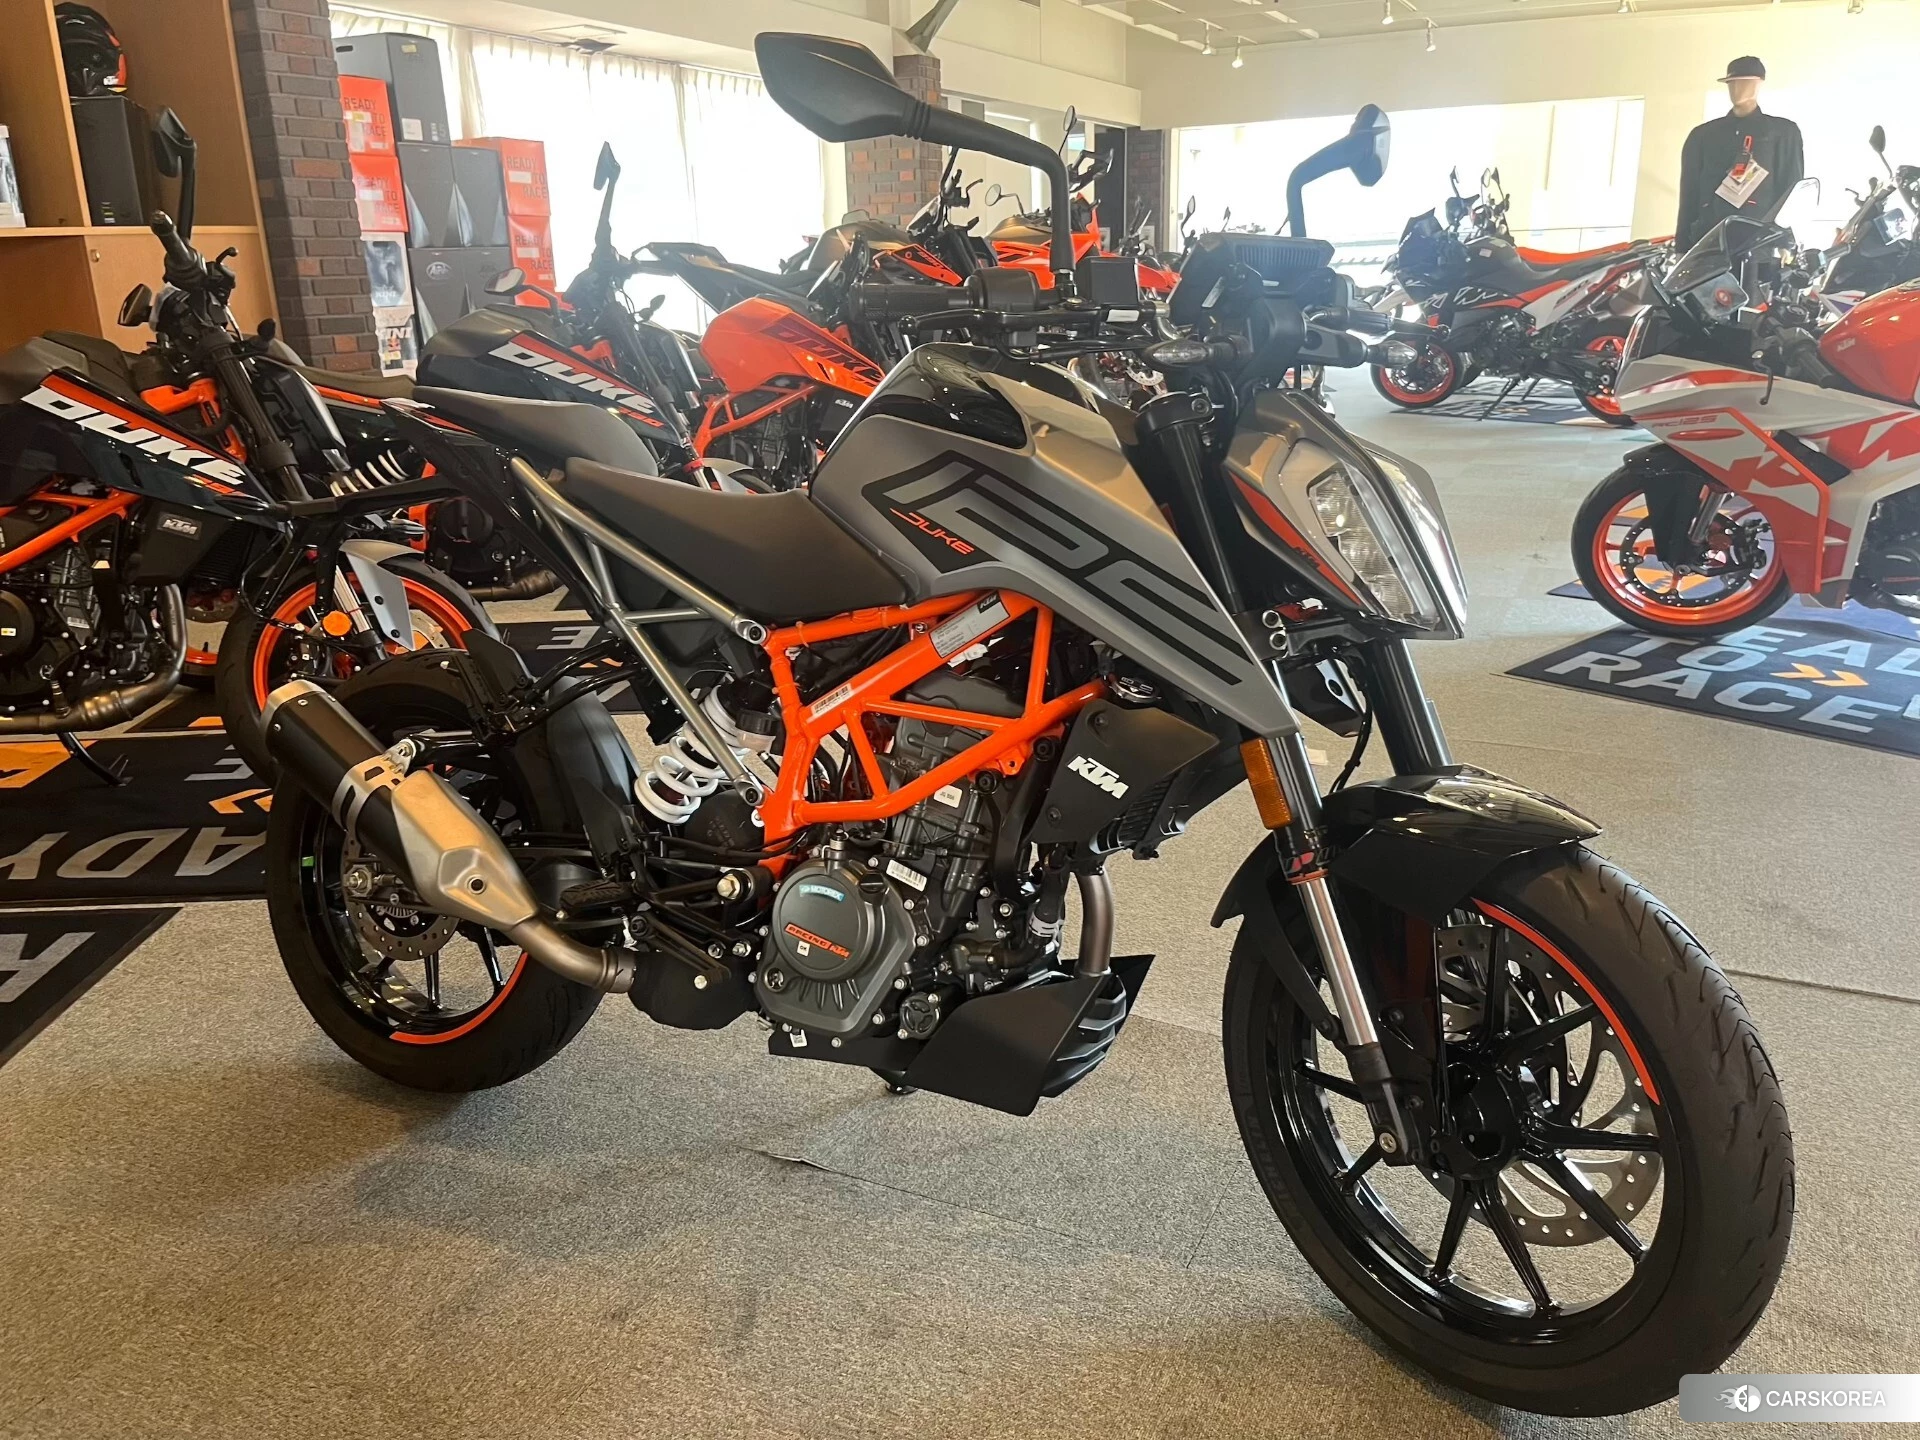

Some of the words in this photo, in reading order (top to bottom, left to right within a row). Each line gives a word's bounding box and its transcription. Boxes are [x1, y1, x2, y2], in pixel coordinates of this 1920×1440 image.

[344, 98, 376, 110] READY
[373, 113, 386, 124] TO
[507, 156, 537, 170] READY
[533, 172, 545, 185] TO
[384, 190, 398, 201] TO
[523, 186, 548, 199] RACE
[515, 234, 545, 247] READY
[541, 247, 553, 259] TO
[530, 260, 553, 271] RACE
[488, 342, 656, 414] DUKE
[20, 384, 247, 485] DUKE
[162, 519, 198, 535] KTM
[889, 507, 976, 555] DUKE
[1544, 651, 1903, 734] RACE
[1067, 755, 1129, 799] KTM
[788, 926, 828, 947] RACING
